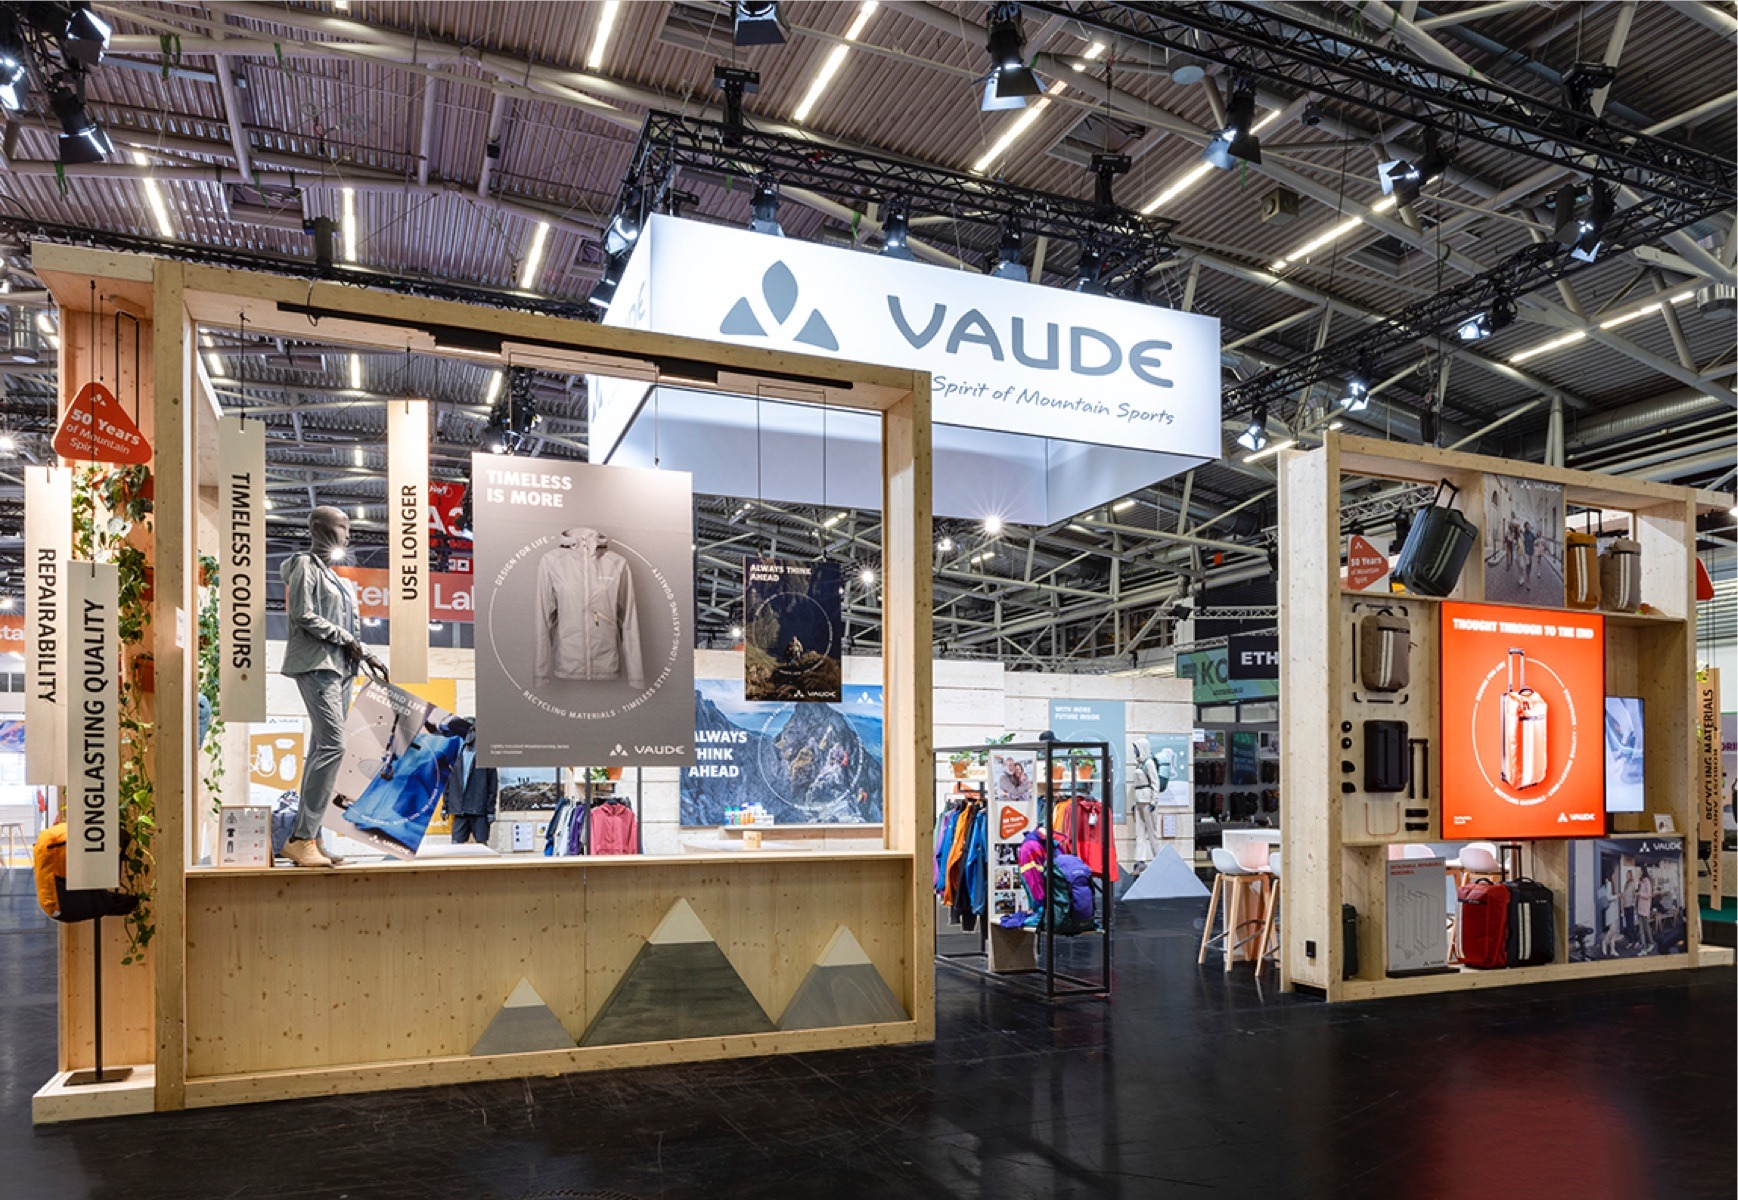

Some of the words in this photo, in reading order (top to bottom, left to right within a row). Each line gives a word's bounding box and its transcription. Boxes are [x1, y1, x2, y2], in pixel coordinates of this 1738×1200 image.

[887, 294, 1174, 389] VAUDE
[931, 375, 990, 398] Spirit
[991, 386, 1015, 402] of
[1015, 388, 1110, 416] Mountain
[1116, 402, 1175, 425] Sports
[66, 424, 79, 433] of
[80, 428, 130, 455] Mountain
[71, 408, 93, 425] 50
[98, 418, 139, 445] Years
[486, 468, 573, 490] TIMELESS
[486, 488, 505, 503] IS
[510, 490, 564, 508] MORE
[231, 472, 250, 567] TIMELESS
[401, 484, 417, 561] LONGER
[515, 544, 531, 560] FOR
[402, 565, 418, 601] USE
[749, 564, 784, 573] ALWAYS
[787, 566, 812, 576] THINK
[749, 573, 780, 582] AHEAD
[434, 583, 475, 610] La
[38, 548, 57, 703] REPAIRABILITY
[232, 573, 251, 669] COLOURS
[1453, 618, 1497, 632] THOUGHT
[1499, 621, 1543, 636] THROUGH
[1545, 625, 1556, 637] TO
[1558, 626, 1574, 638] THE
[1576, 628, 1594, 639] END
[84, 599, 108, 693] QUALITY
[1241, 651, 1278, 665] ETH
[522, 689, 567, 717] RECYCLING
[568, 708, 616, 720] MATERIALS
[694, 730, 748, 743] LWAYS
[1703, 689, 1713, 753] MATERIALS
[634, 745, 685, 755] VAUDE
[694, 747, 734, 761] HINK
[84, 700, 106, 853] LONGLASTING
[688, 765, 740, 778] AHEAD
